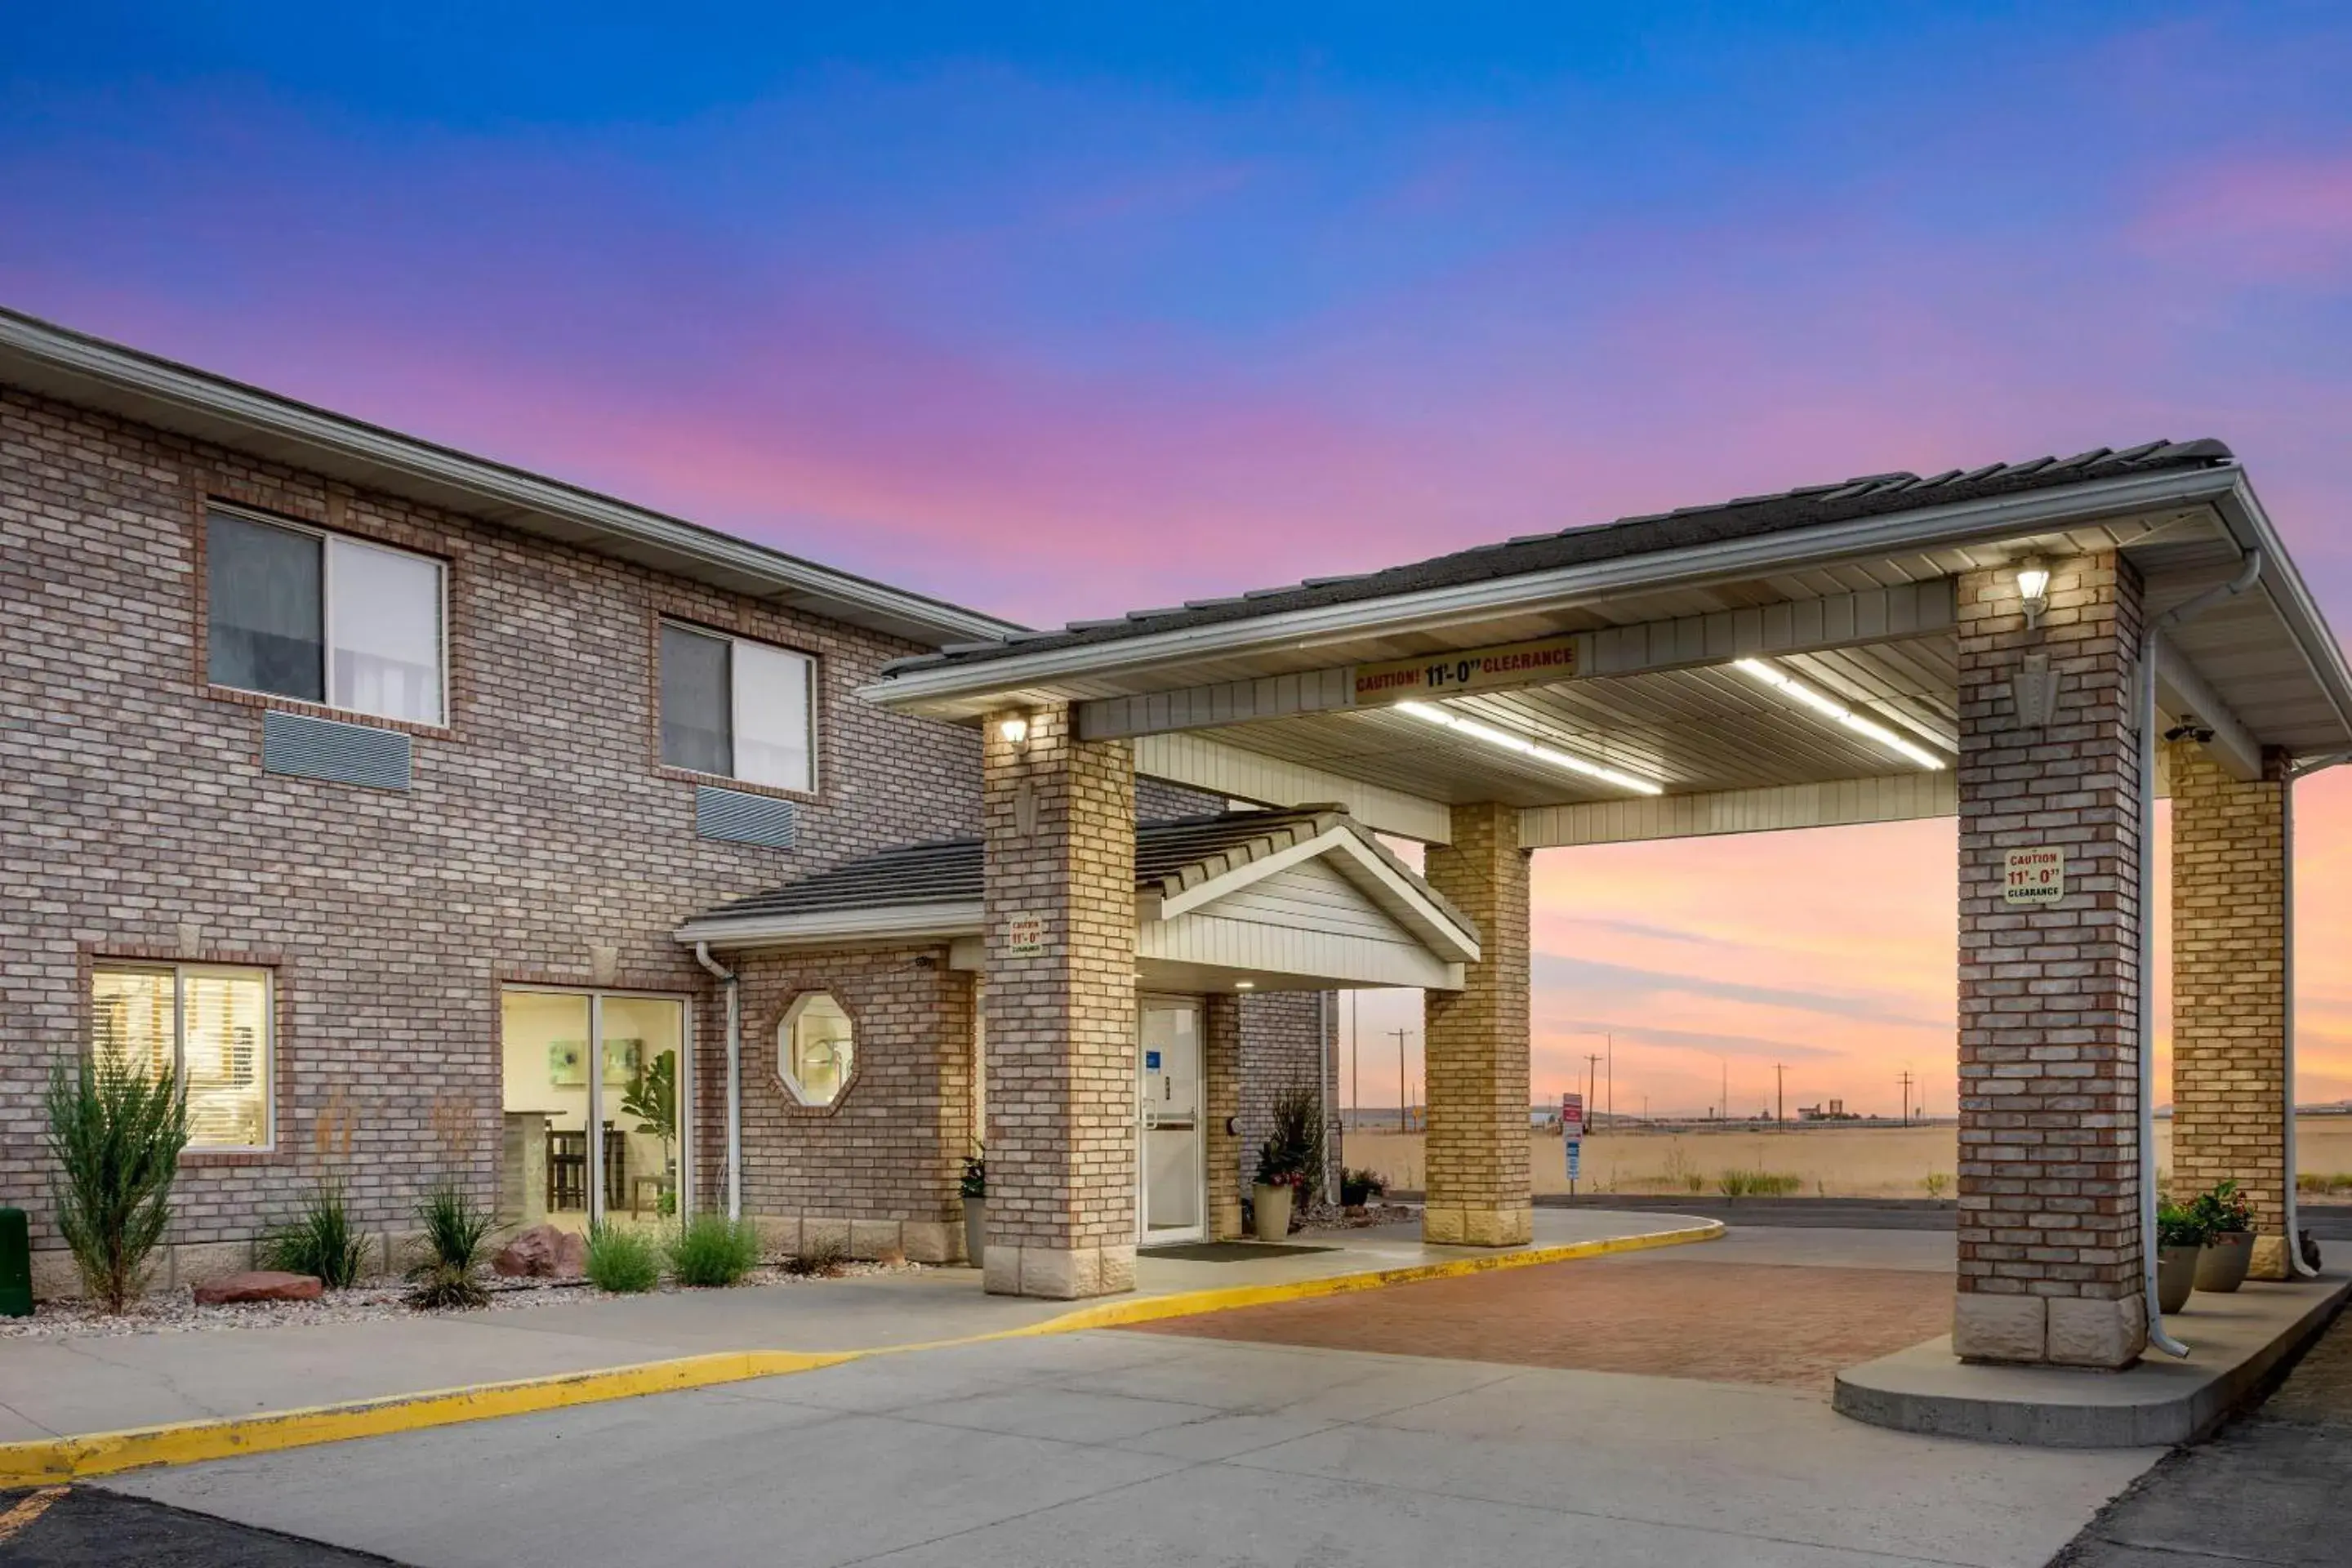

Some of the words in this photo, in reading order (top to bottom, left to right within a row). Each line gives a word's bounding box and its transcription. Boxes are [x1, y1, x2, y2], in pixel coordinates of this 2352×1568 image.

[1356, 669, 1419, 692] CAUTION!
[1483, 648, 1573, 673] CLEARANCE
[2010, 853, 2057, 866] CAUTION
[2008, 887, 2058, 898] CLEARANCE
